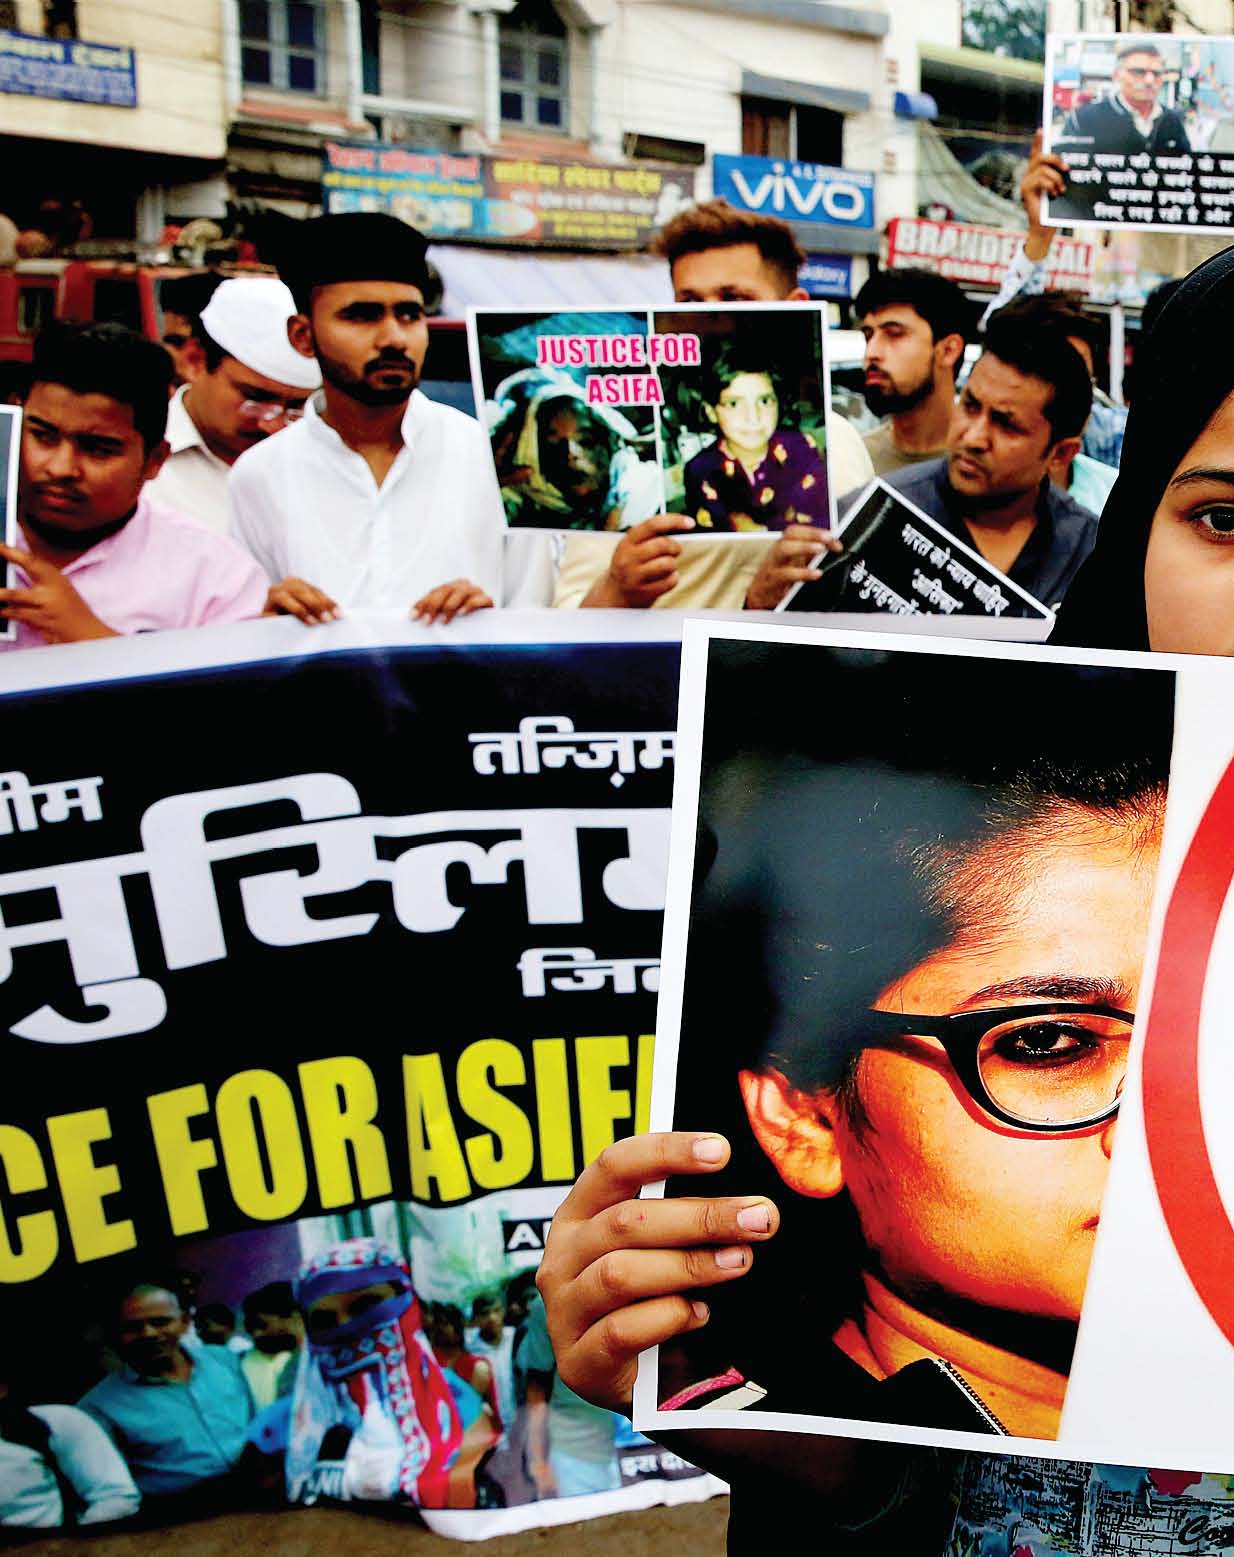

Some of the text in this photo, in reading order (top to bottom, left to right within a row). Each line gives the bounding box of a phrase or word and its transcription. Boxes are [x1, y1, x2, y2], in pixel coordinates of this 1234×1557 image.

[538, 336, 700, 367] JUSTICE FOR
[587, 376, 662, 404] ASIFA
[0, 770, 104, 836] ीम
[146, 1055, 394, 1238] FOR
[402, 1034, 656, 1202] ASIF
[507, 1222, 552, 1250] A
